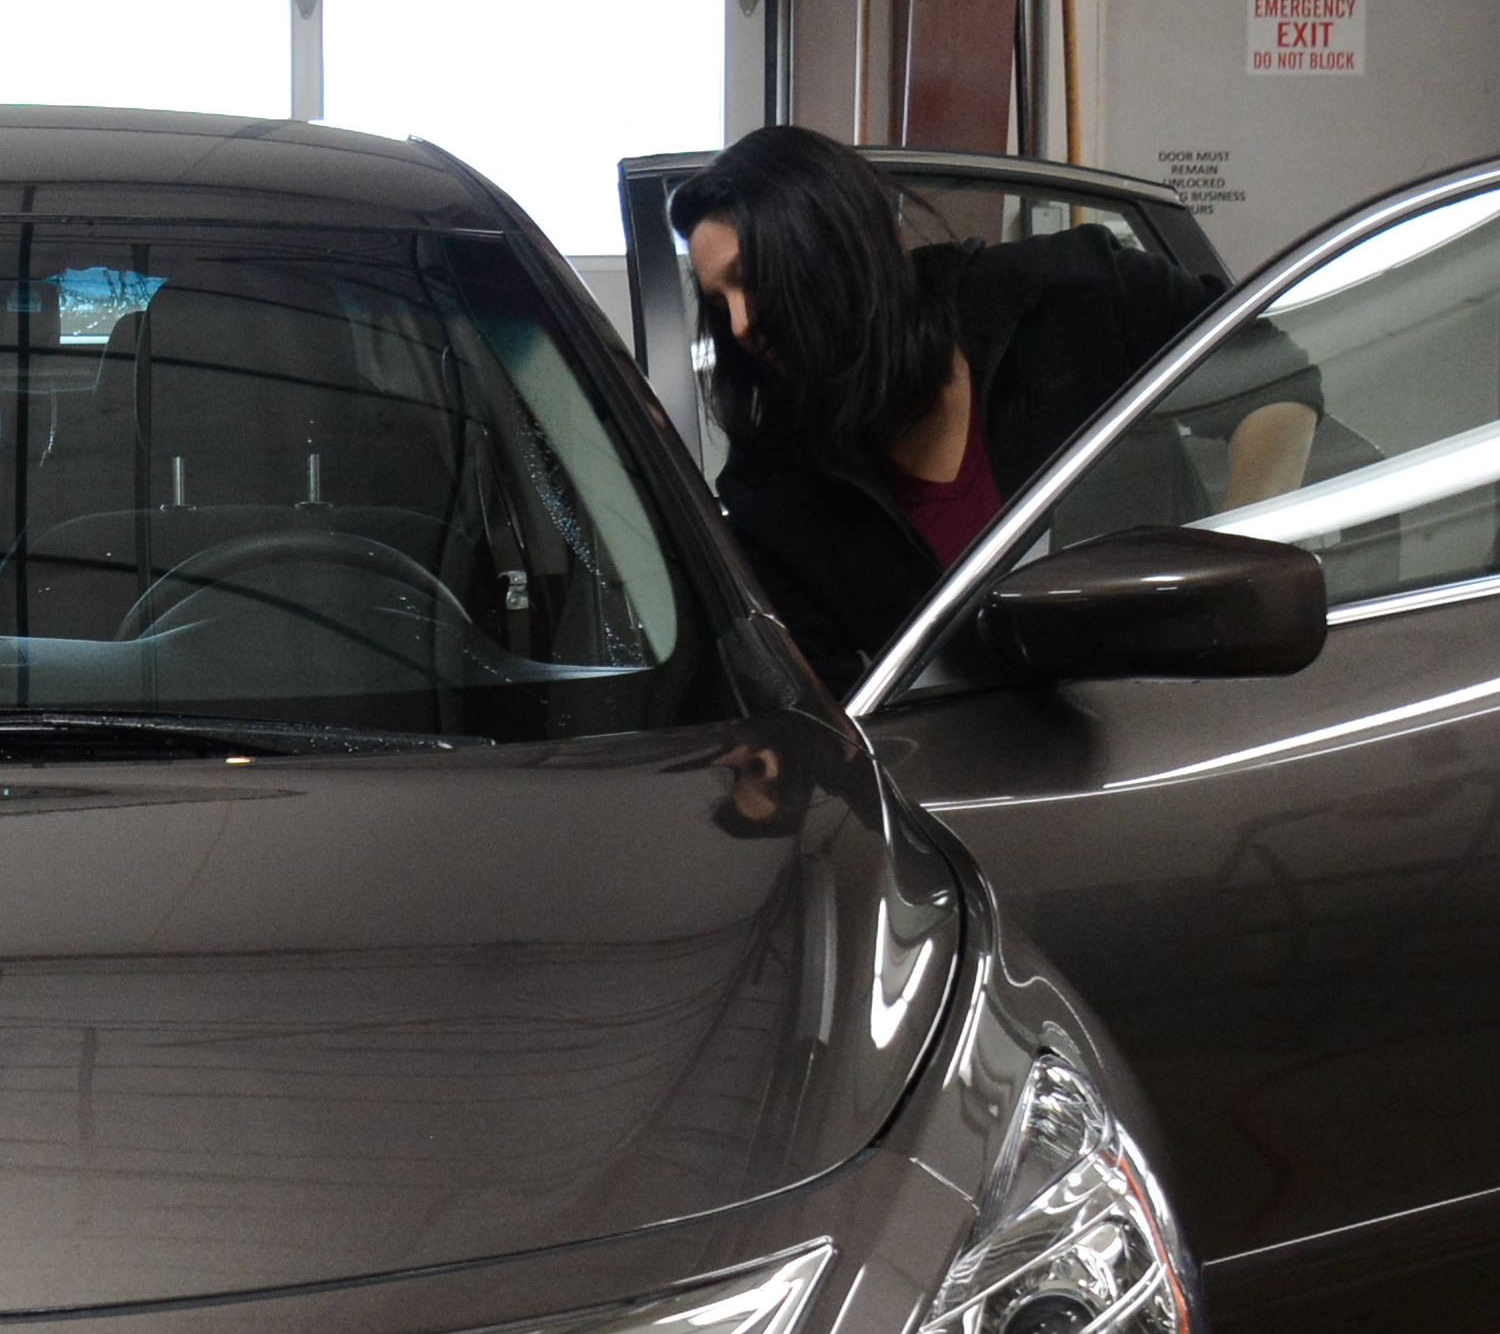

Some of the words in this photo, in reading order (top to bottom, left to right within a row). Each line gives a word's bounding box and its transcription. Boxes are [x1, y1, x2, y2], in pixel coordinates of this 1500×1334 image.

[1277, 22, 1334, 48] EXIT
[1253, 52, 1272, 70] DO
[1277, 52, 1304, 70] NOT
[1309, 51, 1355, 69] BLOCK
[1158, 152, 1193, 161] DOOR
[1196, 152, 1230, 161] MUST
[1171, 165, 1218, 175] REMAIN
[1162, 178, 1225, 188] UNLOCKED
[1191, 191, 1246, 201] BUSINESS
